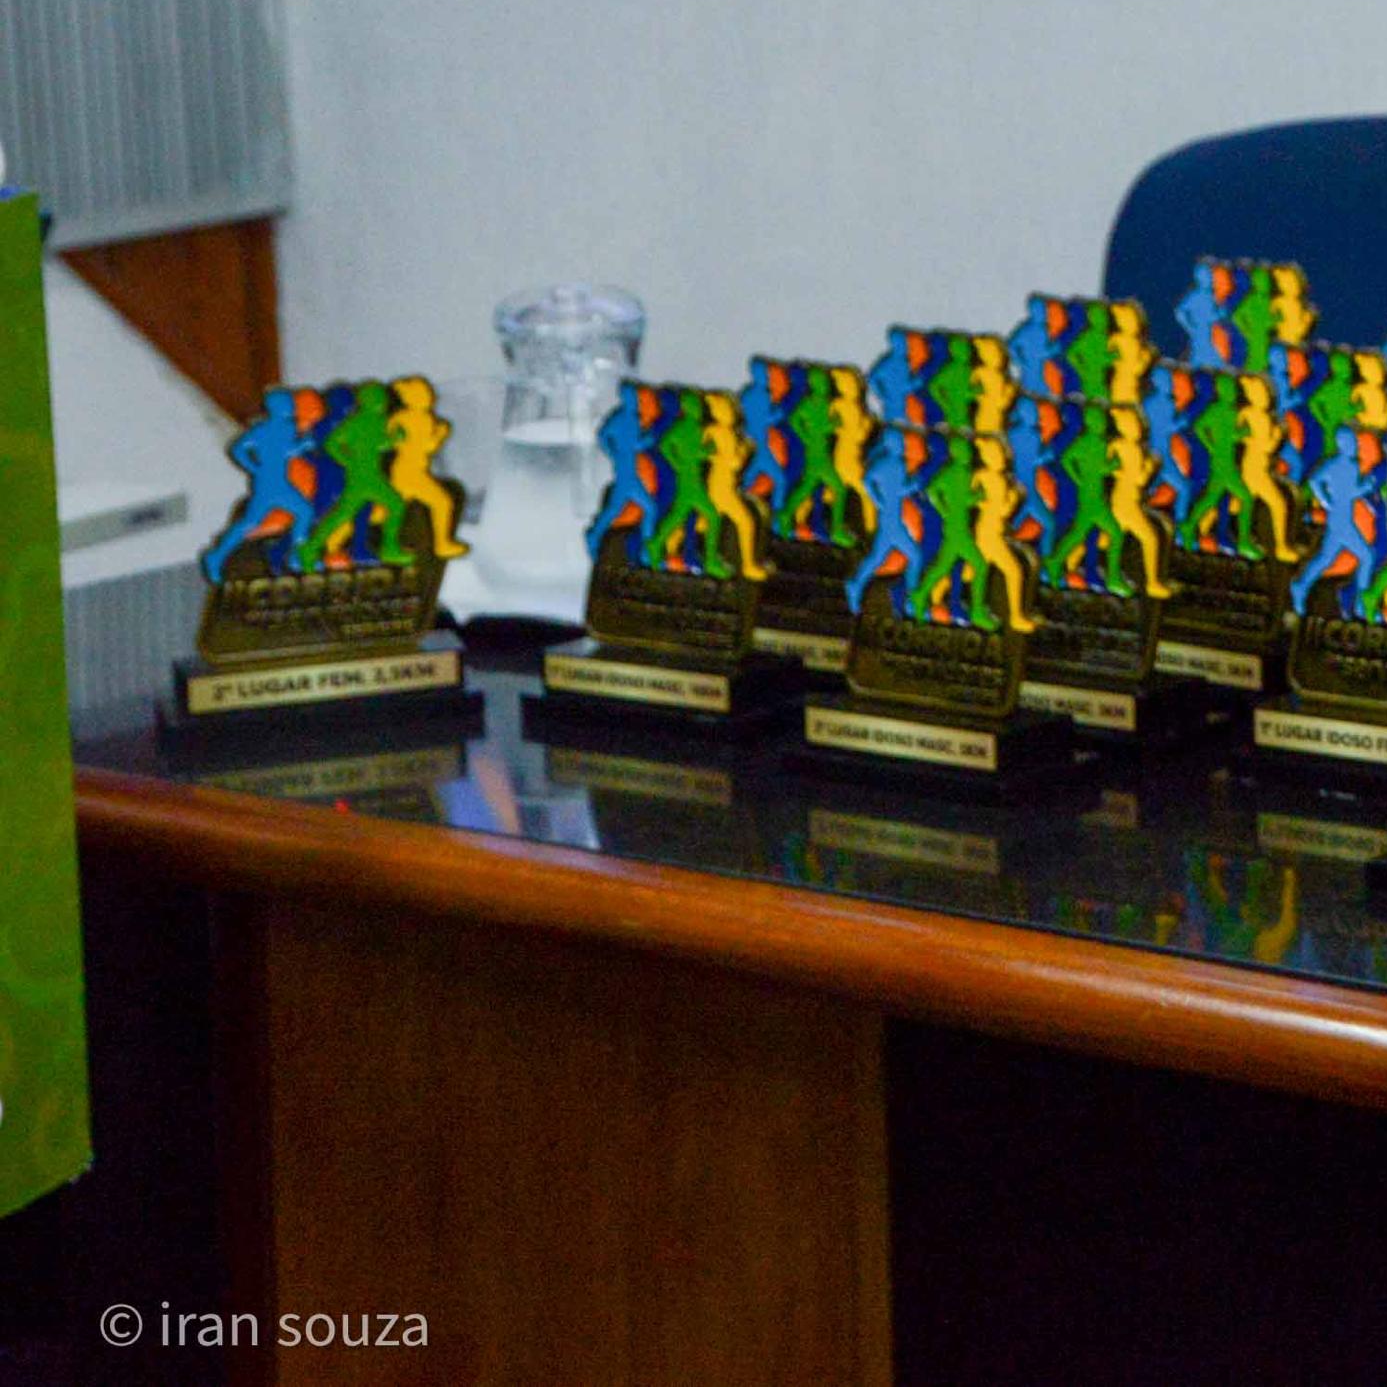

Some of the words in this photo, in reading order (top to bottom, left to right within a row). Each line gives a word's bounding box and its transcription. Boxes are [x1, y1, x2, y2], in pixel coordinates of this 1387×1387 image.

[236, 675, 312, 699] LUGAR
[1275, 723, 1322, 742] LUGAR
[1327, 731, 1373, 749] IDOSO
